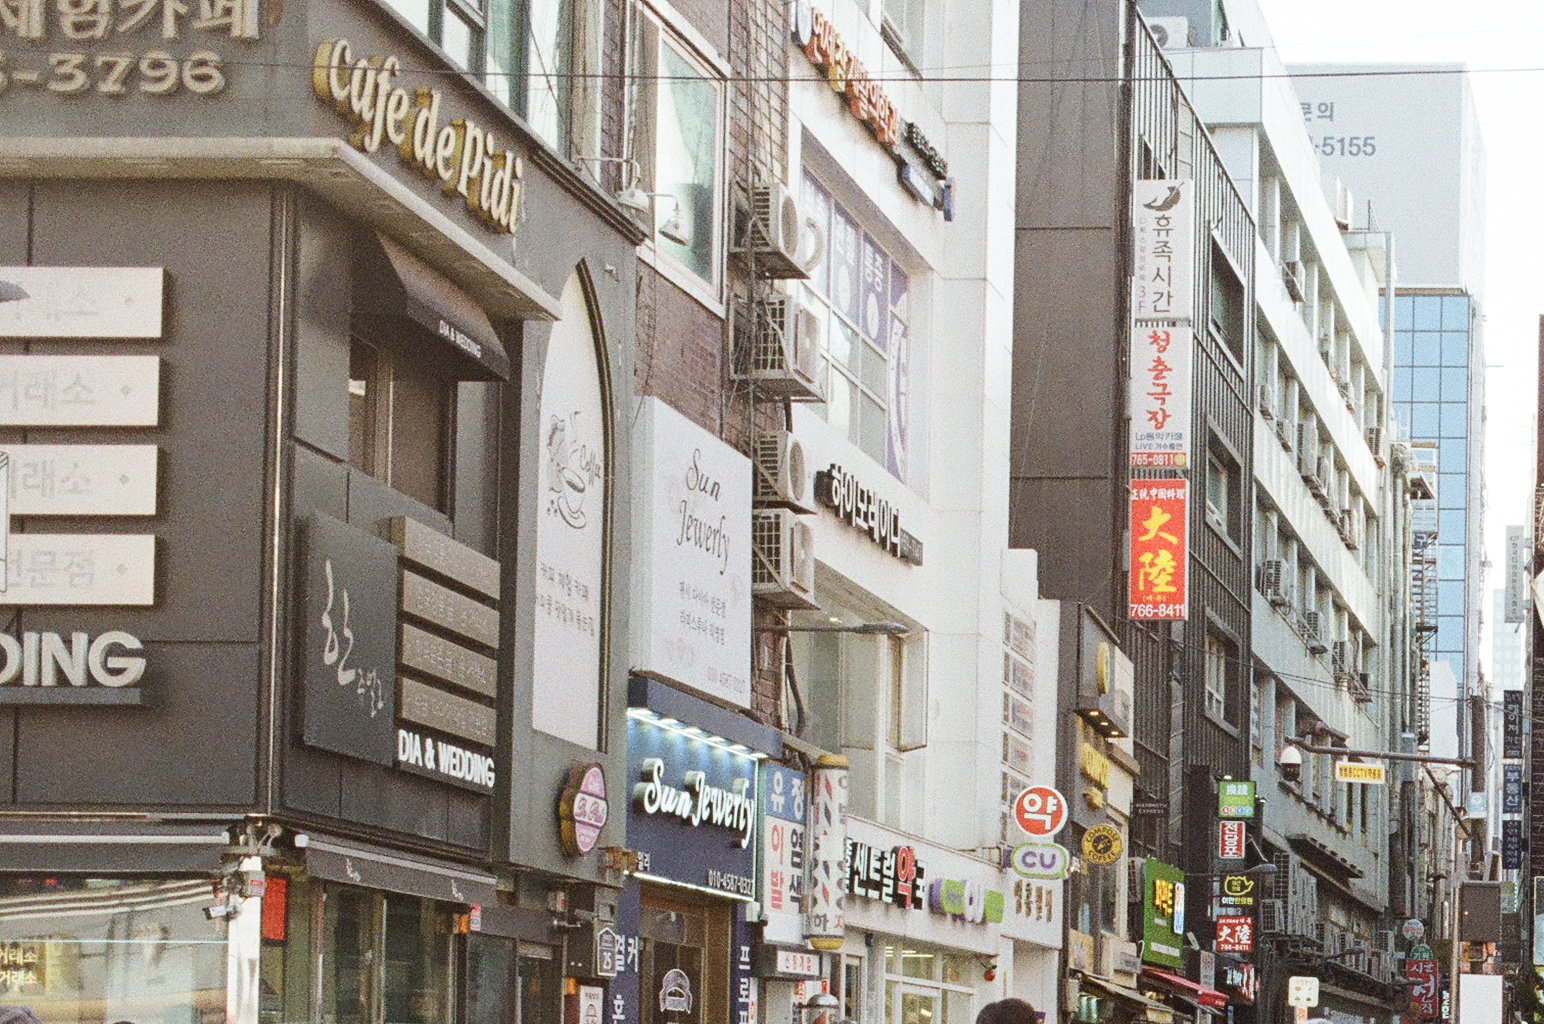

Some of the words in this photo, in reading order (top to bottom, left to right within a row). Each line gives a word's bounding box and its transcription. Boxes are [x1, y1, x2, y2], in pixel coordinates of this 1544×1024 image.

[322, 39, 408, 152] Cafe
[414, 91, 456, 187] de
[1151, 213, 1174, 313] 휴족시간
[1146, 330, 1174, 430] 청춘극장
[686, 447, 722, 500] Sun
[830, 464, 902, 558] 하이모레이디
[1138, 506, 1179, 594] 大陸
[1130, 601, 1186, 618] 766-8411
[398, 729, 424, 767] DIA
[426, 738, 436, 766] &
[438, 741, 496, 789] WEDDING
[644, 758, 691, 819] Sun
[1023, 793, 1059, 831] 약
[1085, 825, 1119, 843] COMPOSE
[770, 824, 785, 911] 이발
[1022, 850, 1057, 869] CU
[1087, 849, 1117, 863] COFFEE
[1217, 924, 1252, 945] 大陸
